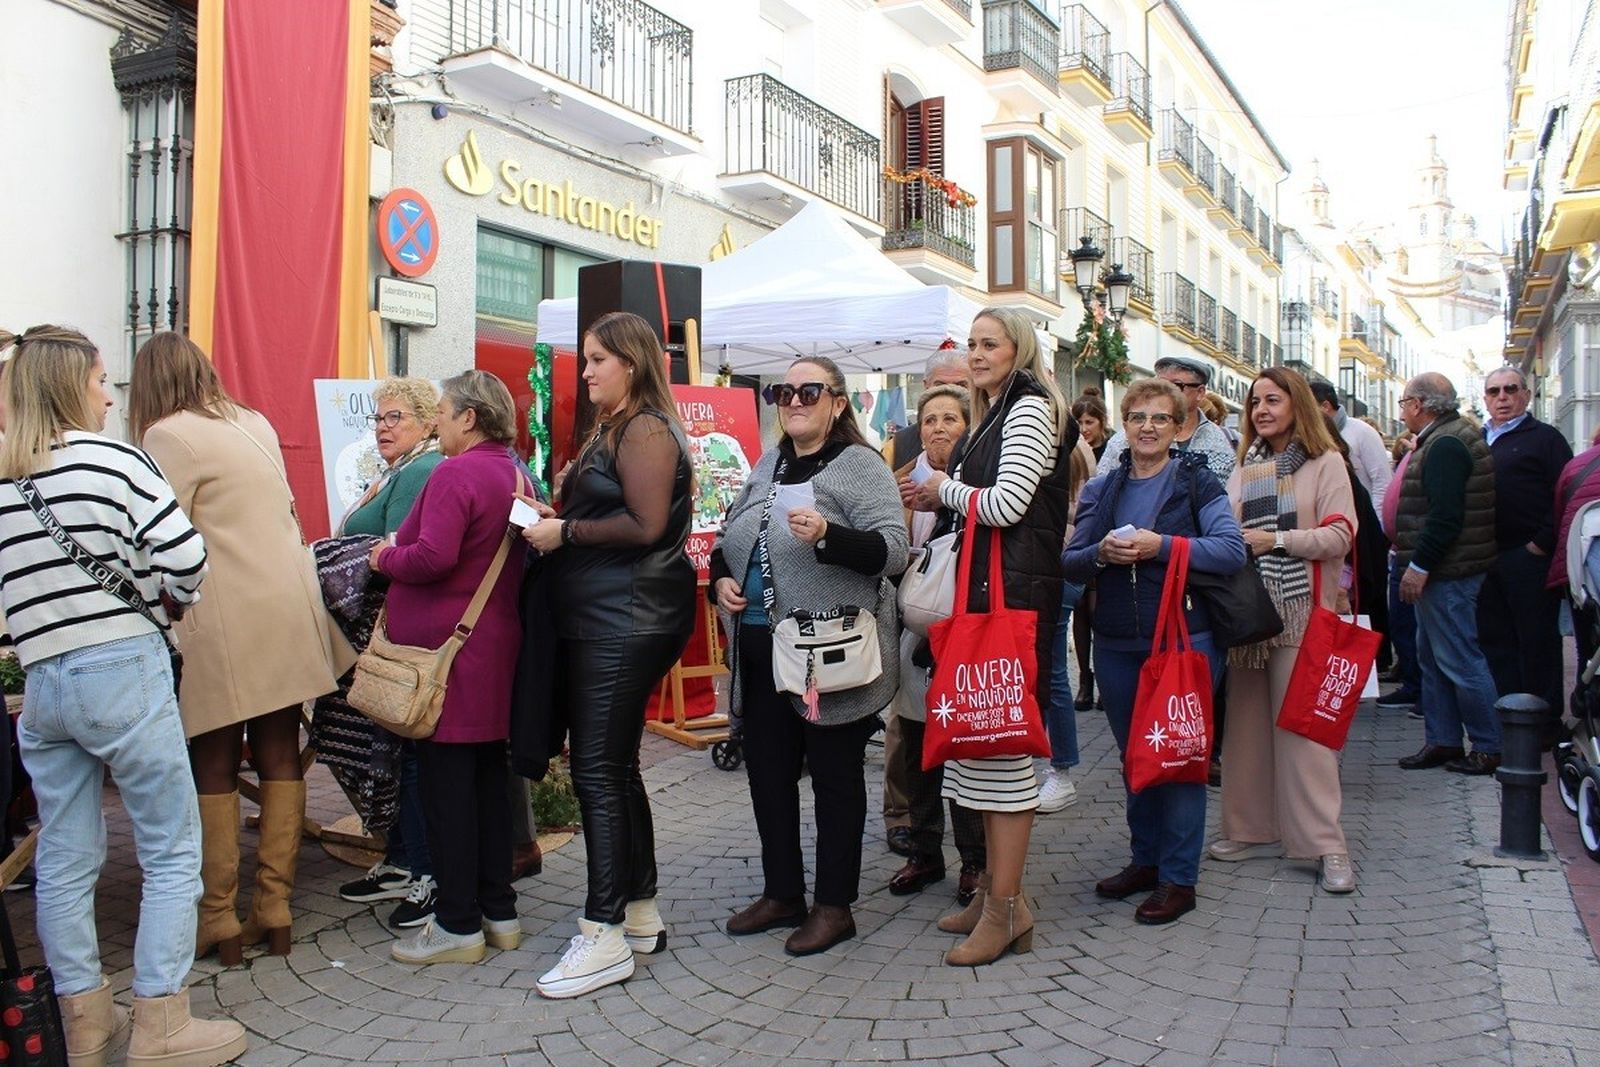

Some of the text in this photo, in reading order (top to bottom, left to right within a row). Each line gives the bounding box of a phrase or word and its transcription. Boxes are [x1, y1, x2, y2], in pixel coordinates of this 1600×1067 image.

[498, 159, 663, 249] Santander
[350, 393, 377, 415] OLV
[677, 402, 714, 421] LVERA
[956, 658, 1024, 692] OLVERA
[957, 693, 966, 705] EN
